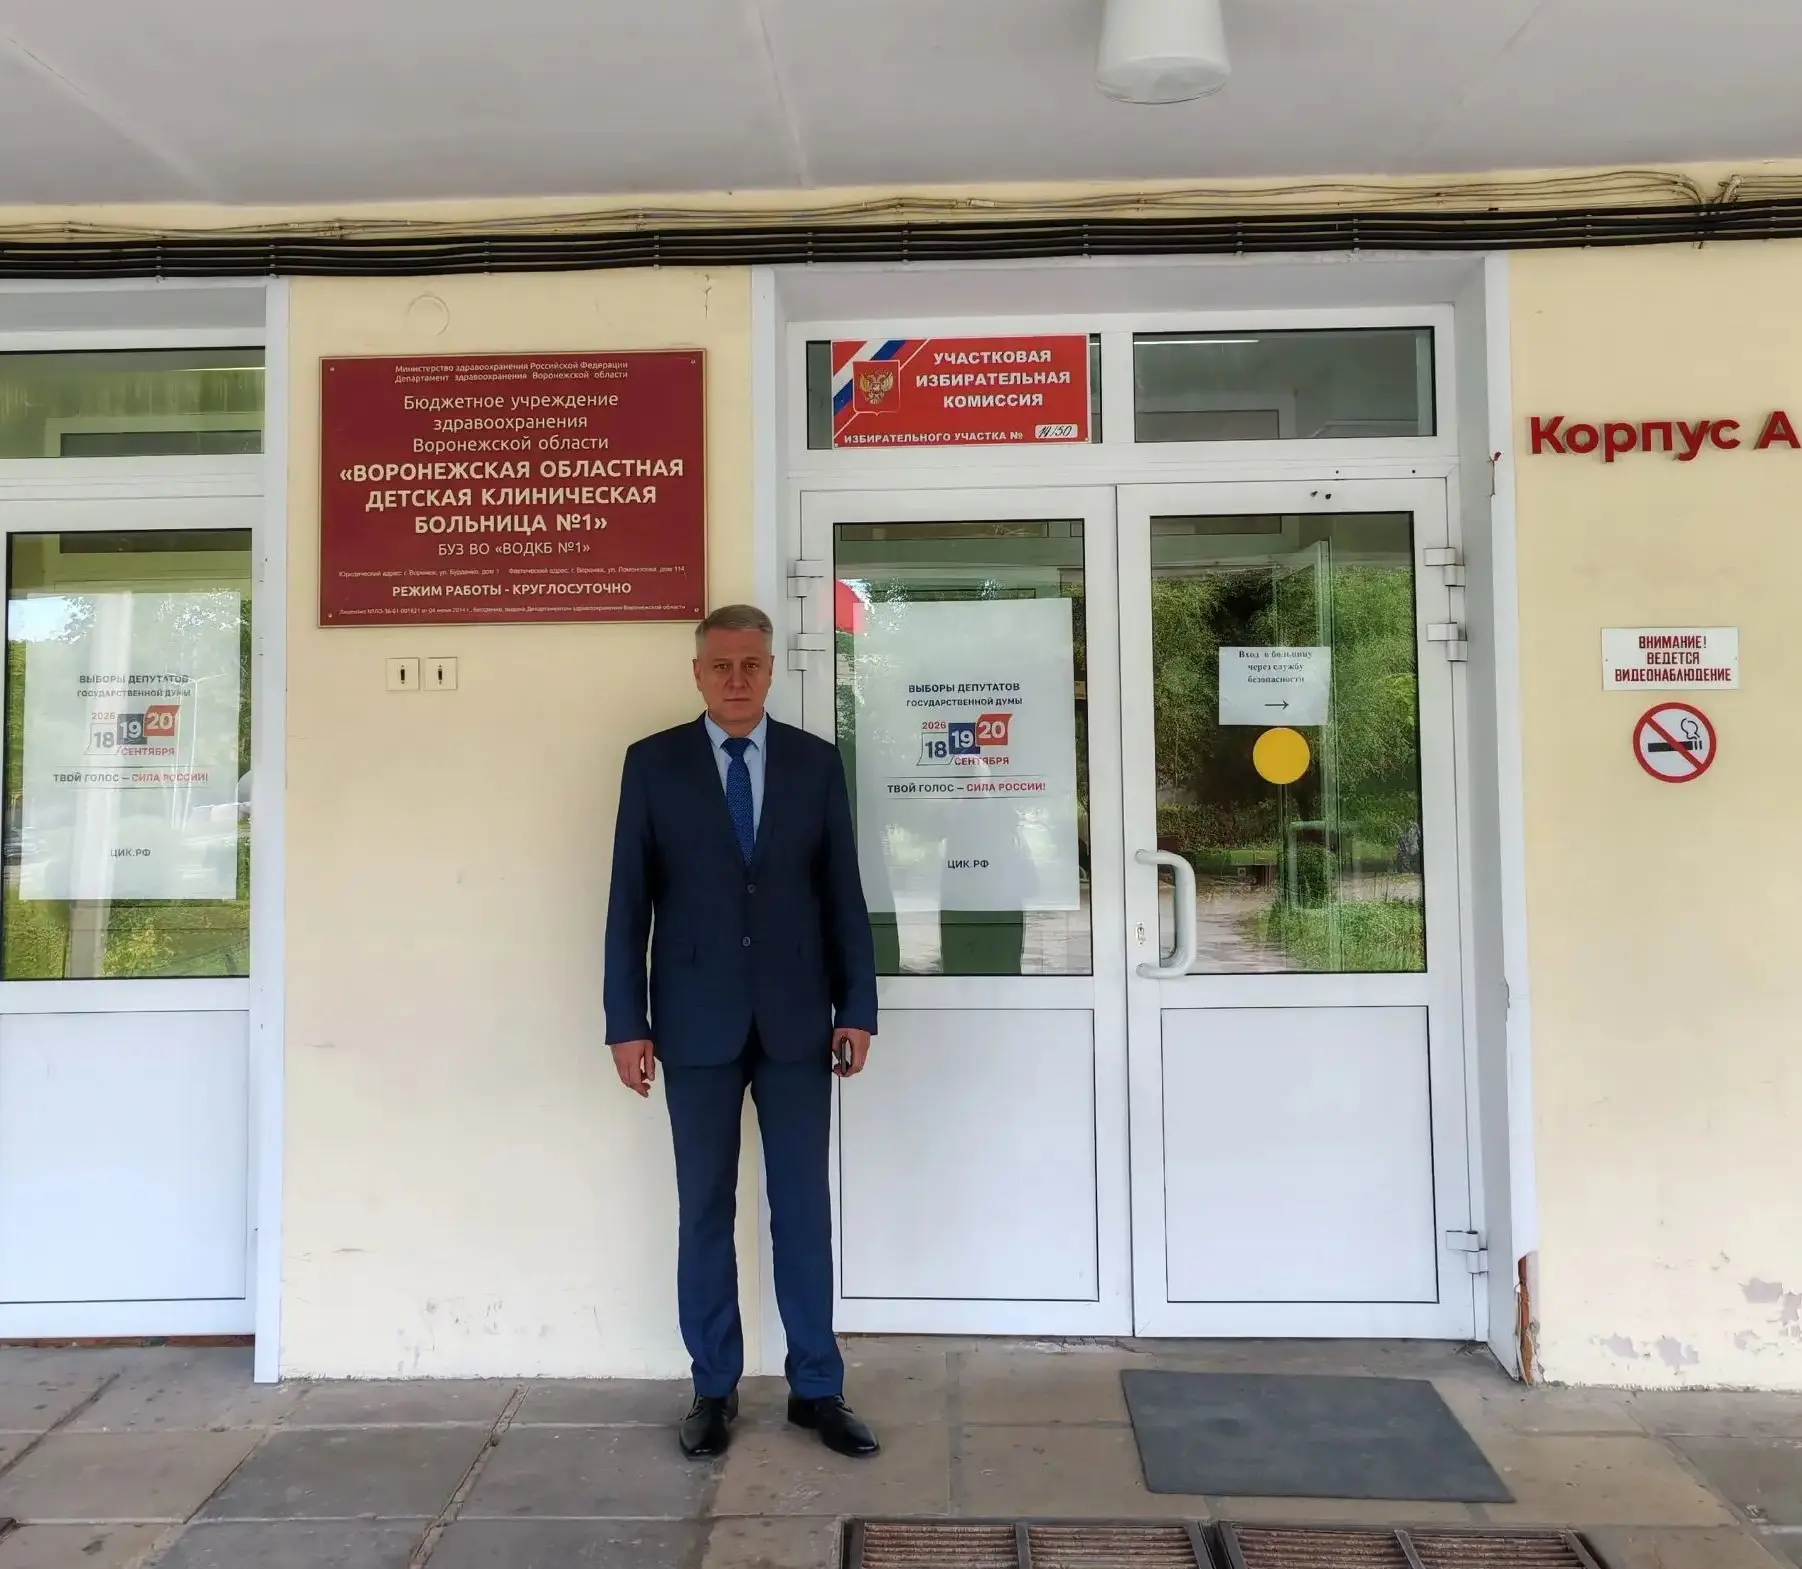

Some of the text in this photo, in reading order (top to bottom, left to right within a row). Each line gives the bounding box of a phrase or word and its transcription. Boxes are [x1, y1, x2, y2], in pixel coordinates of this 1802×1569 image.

[934, 350, 1051, 365] УЧАСТКОВАЯ
[395, 361, 628, 373] Министерство здравоохранения Российской Федерации
[395, 370, 628, 383] Департамент здравоохранения Воронежской области
[916, 371, 1070, 388] ИЗБИРАТЕЛЬНАЯ
[404, 393, 618, 411] Бюджетное учреждение
[944, 393, 1043, 409] КОМИССИЯ
[433, 416, 588, 433] здравоохранения
[844, 433, 950, 444] ИЗБИРАТЕЛЬНОГО
[954, 431, 1007, 442] УЧАСТКА
[1010, 431, 1024, 440] №
[1529, 411, 1802, 463] Корпус А
[413, 435, 609, 454] Воронежской области
[340, 459, 684, 482] «ВОРОНЕЖСКАЯ ОБЛАСТНАЯ
[366, 486, 656, 512] ДЕТСКАЯ КЛИНИЧЕСКАЯ
[415, 513, 608, 536] БОЛЬНИЦА №1»
[438, 541, 591, 557] БУЗ ВО «ВОДКБ №1»
[392, 586, 442, 597] РЕЖИМ
[446, 585, 501, 596] РАБОТЫ
[512, 582, 632, 596] КРУГЛОСУТОЧНО
[1639, 636, 1707, 649] ВНИМАНИЕ!
[1647, 652, 1700, 665] ВЕДЕТСЯ
[1273, 663, 1305, 672] службу
[79, 674, 189, 685] ВЫБОРЫ ДЕПУТАТОВ
[1615, 668, 1732, 682] ВИДЕОНАБЛЮДЕНИЕ
[76, 688, 163, 699] ГОСУДАРСТВЕННОЙ
[908, 682, 1020, 694] ВЫБОРЫ ДЕПУТАТОВ
[906, 697, 1023, 708] ГОСУДАРСТВЕННОЙ ДУМЫ
[91, 712, 116, 720] 2026
[147, 713, 174, 730] 20
[119, 722, 144, 739] 19
[922, 721, 947, 730] 2026
[978, 720, 1006, 739] 20
[93, 731, 115, 749] 18
[951, 730, 974, 749] 19
[121, 747, 175, 757] СЕНТЯБРЯ
[925, 741, 948, 759] 18
[954, 756, 1010, 766] СЕНТЯБРЯ
[53, 771, 82, 783] ТВОЙ
[84, 773, 119, 783] ГОЛОС
[131, 773, 161, 783] СИЛА
[163, 773, 209, 783] РОССИИ!
[888, 782, 916, 793] ТВОЙ
[918, 783, 954, 793] ГОЛОС
[966, 783, 996, 793] СИЛА
[998, 781, 1047, 792] РОССИИ!
[110, 848, 151, 858] ЦИК.РФ
[947, 859, 989, 870] ЦИК.РФ
